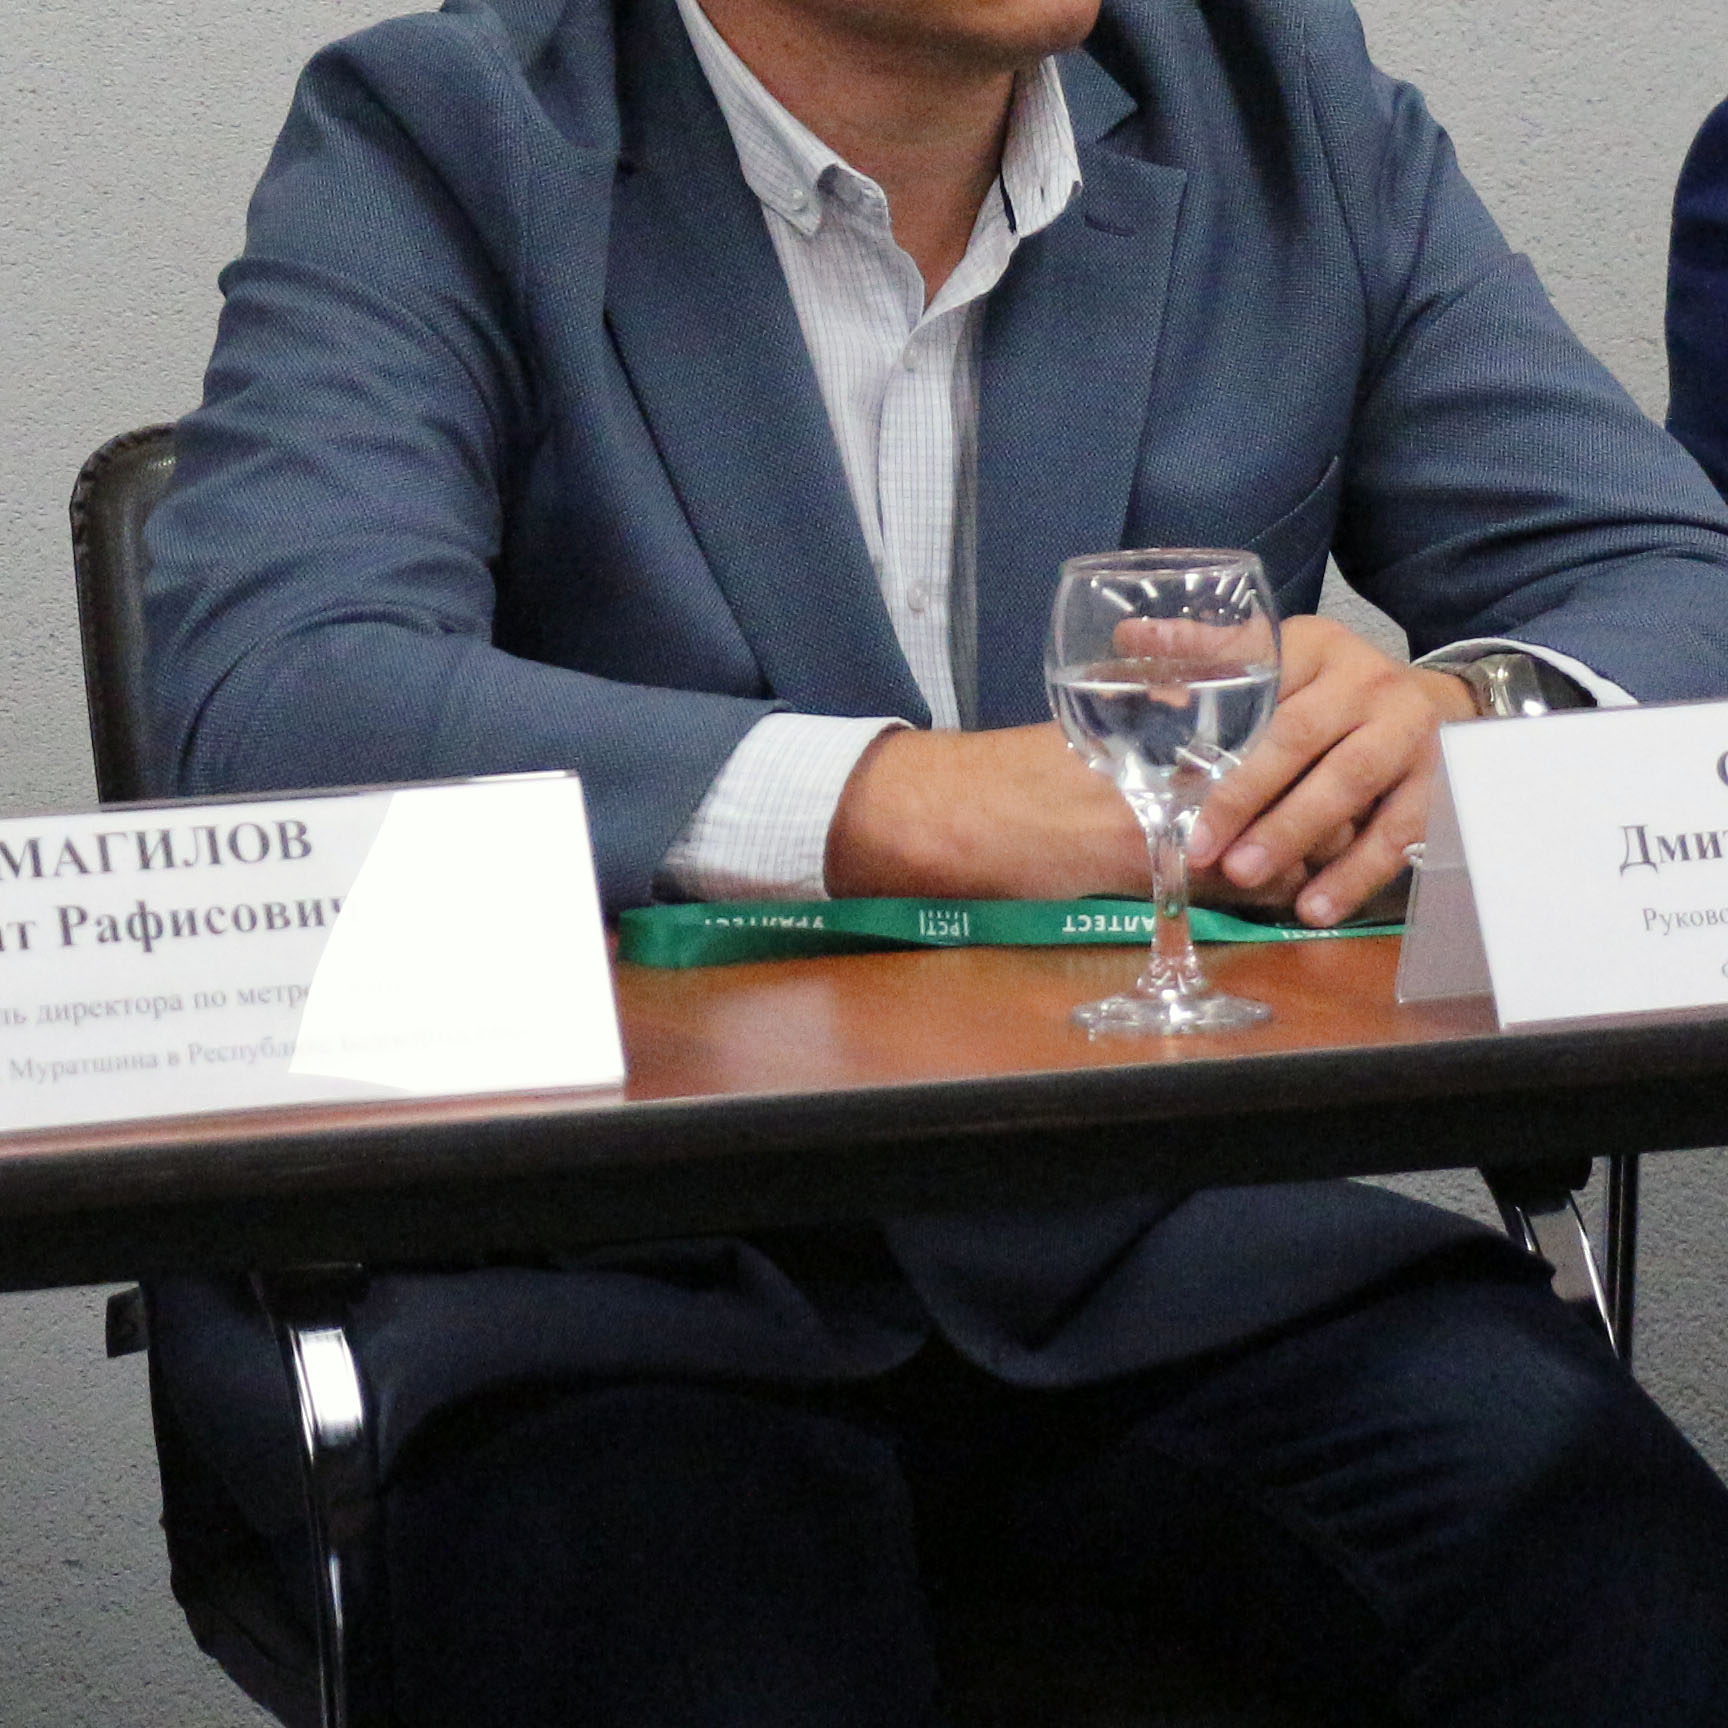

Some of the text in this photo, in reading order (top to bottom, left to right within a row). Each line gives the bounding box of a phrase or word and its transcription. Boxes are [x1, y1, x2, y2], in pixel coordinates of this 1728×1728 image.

[1062, 914, 1156, 933] АЛТЕСТ
[35, 993, 186, 1029] директора
[192, 990, 229, 1011] по
[235, 983, 310, 1010] метр
[166, 1051, 183, 1069] в
